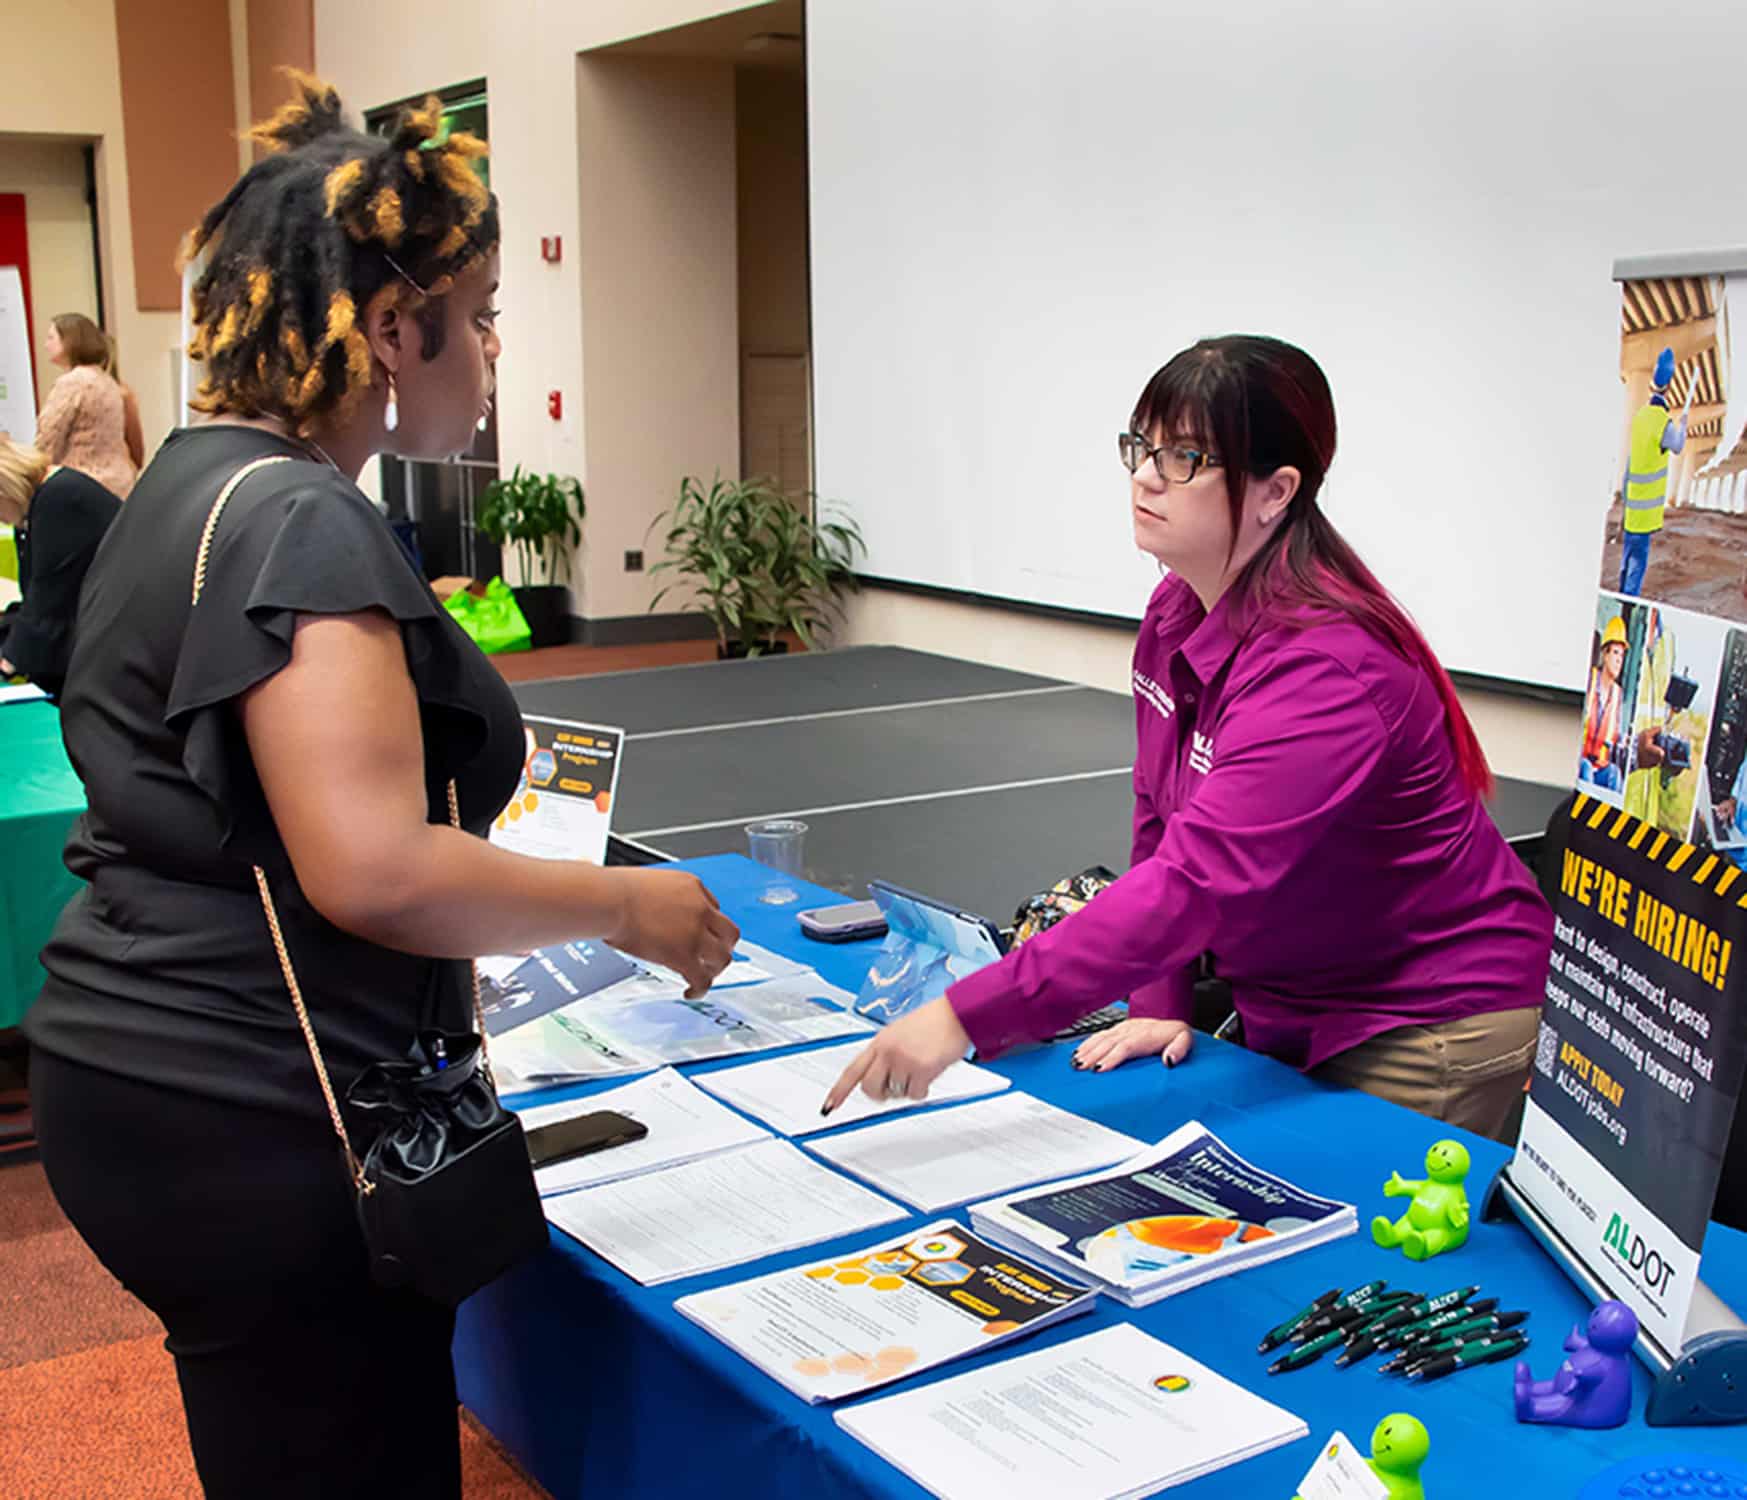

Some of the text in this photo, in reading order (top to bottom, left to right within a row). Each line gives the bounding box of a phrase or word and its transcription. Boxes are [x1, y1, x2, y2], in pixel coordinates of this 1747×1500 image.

[1561, 847, 1732, 991] WE'RE HIRING!
[1564, 960, 1605, 1001] maintain
[1605, 985, 1622, 1013] the
[1622, 996, 1692, 1065] infrastructure
[1691, 1046, 1714, 1082] that
[1575, 930, 1587, 953] to
[1587, 938, 1620, 980] design,
[1621, 964, 1667, 1014] construct,
[1669, 997, 1711, 1039] operate
[1560, 1041, 1625, 1109] APPLY TODAY
[1570, 998, 1587, 1021] our
[1586, 1010, 1611, 1040] state
[1610, 1028, 1645, 1073] moving
[1644, 1051, 1695, 1103] forward?
[1602, 1211, 1677, 1298] ALDOT
